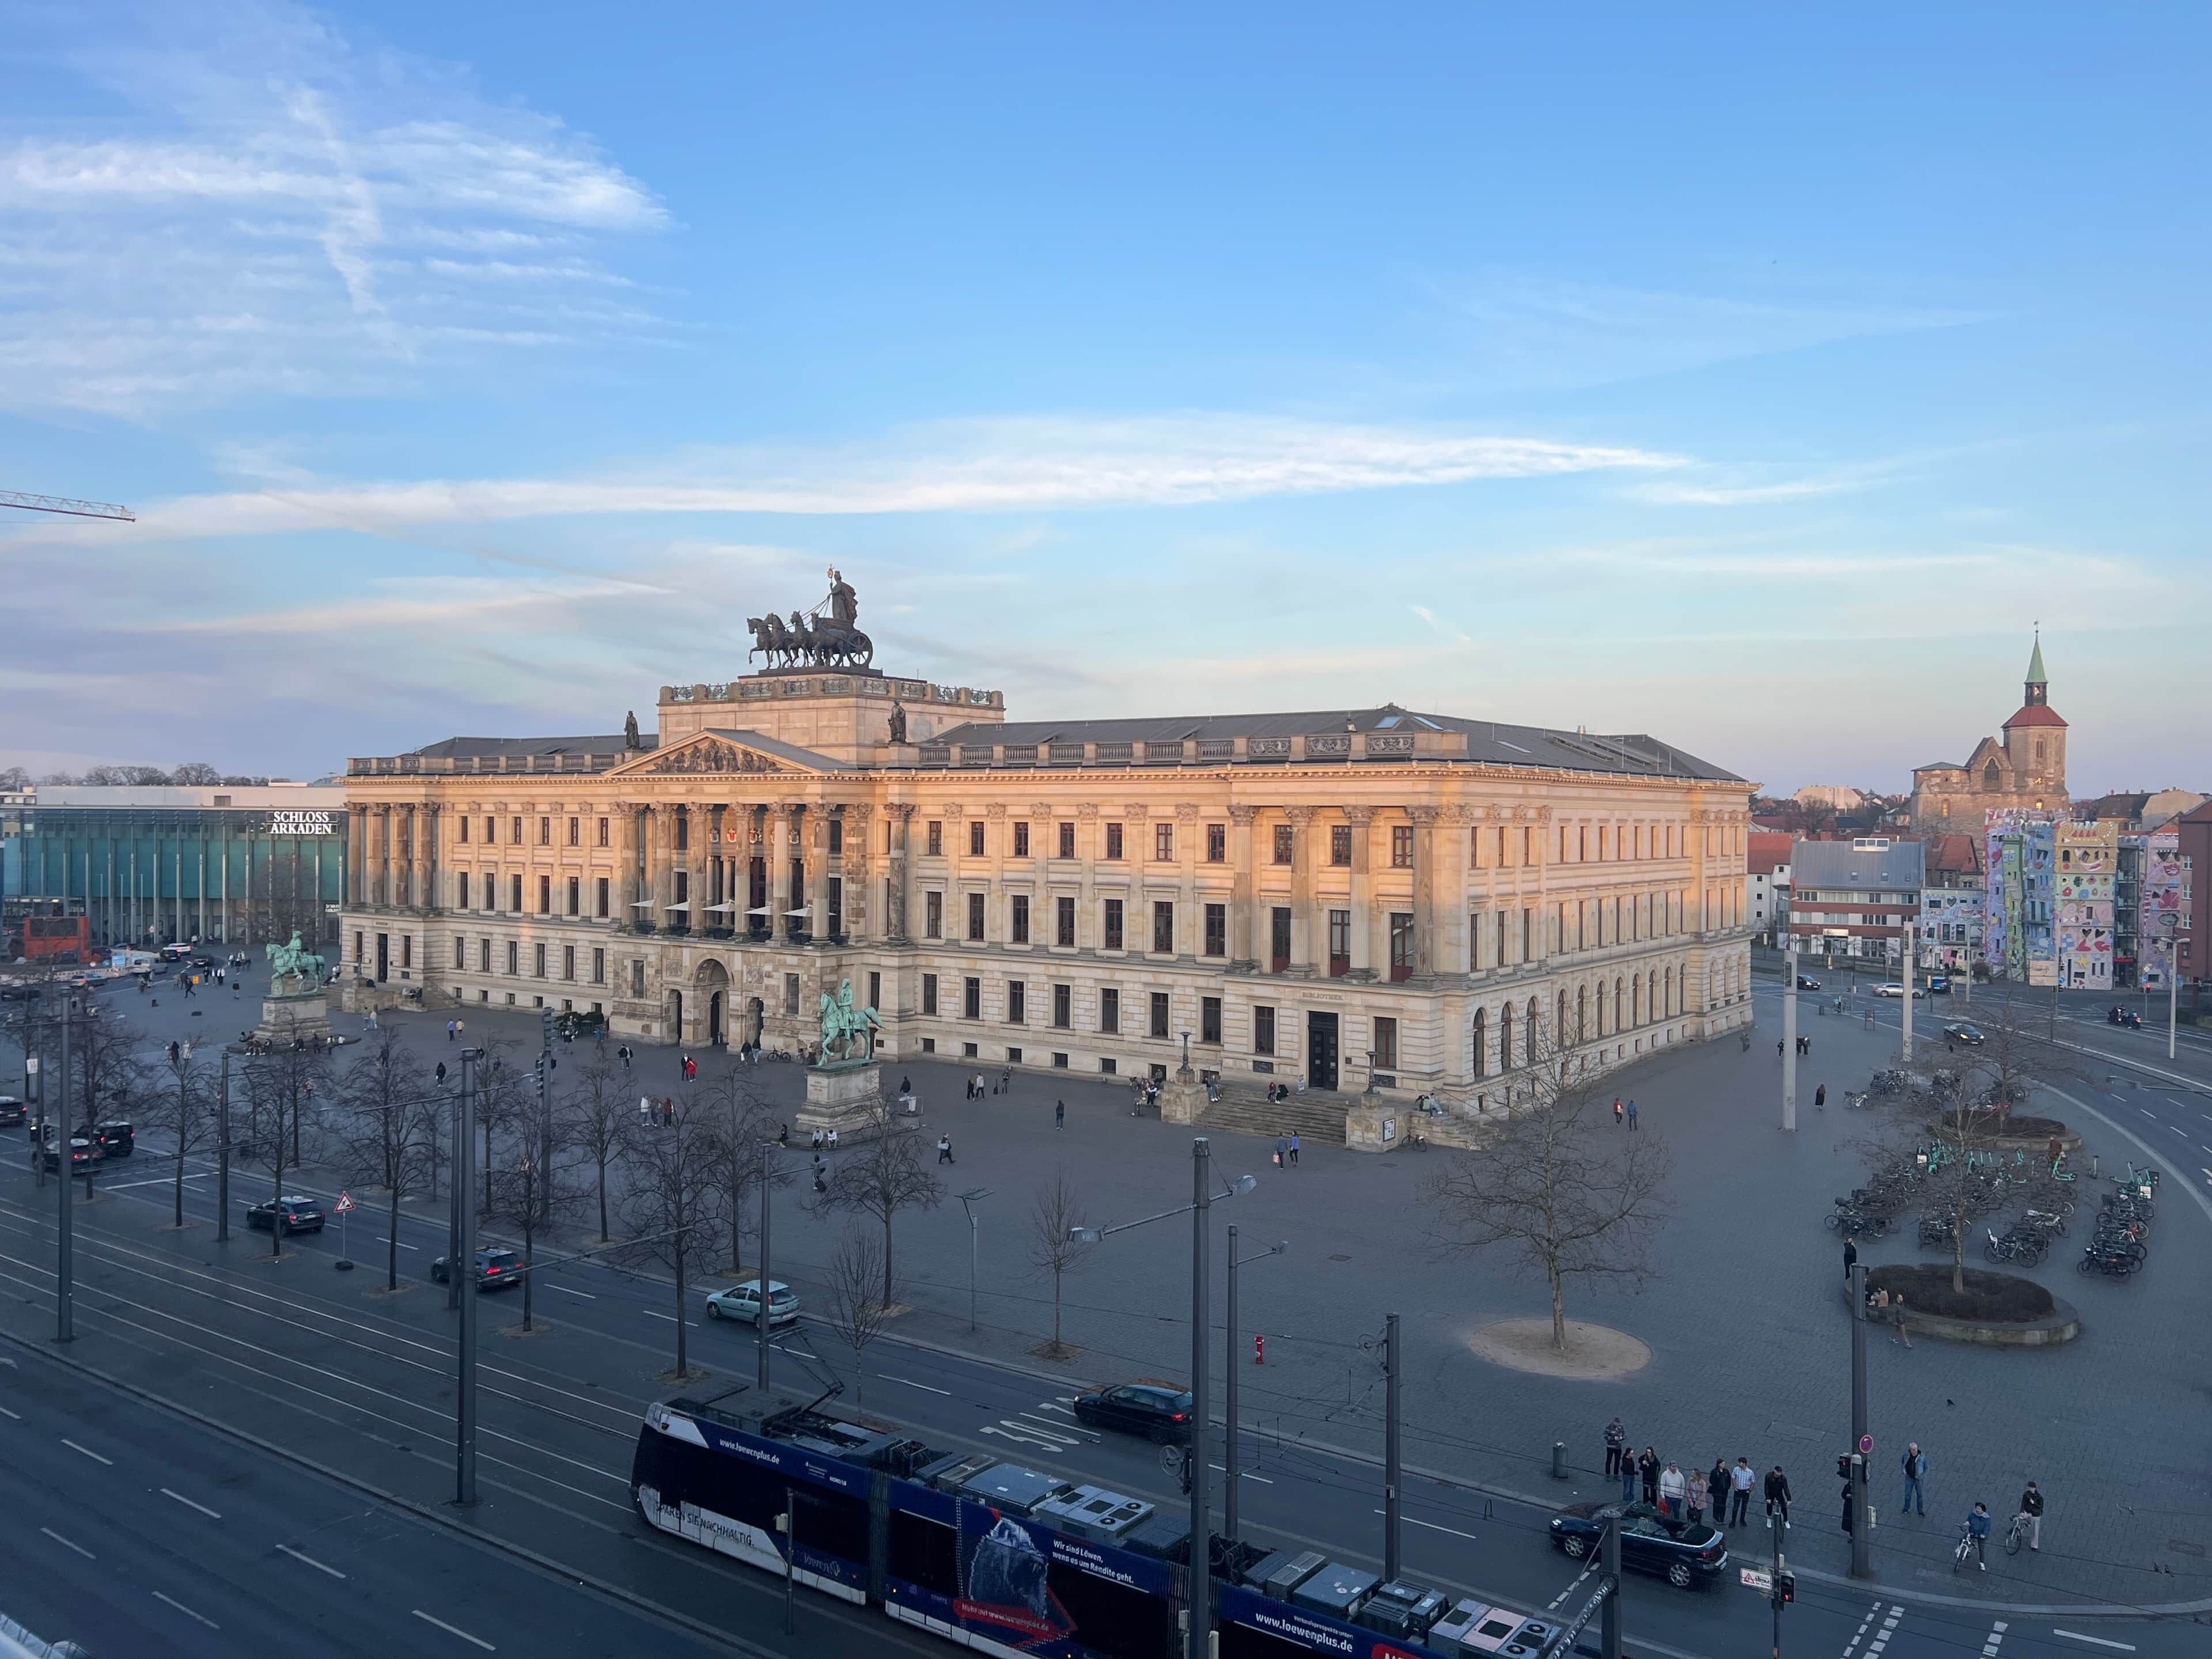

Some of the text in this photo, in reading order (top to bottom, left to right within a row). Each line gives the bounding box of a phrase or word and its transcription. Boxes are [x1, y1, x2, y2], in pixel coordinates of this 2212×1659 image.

[270, 823, 332, 834] ARKADEN
[274, 811, 329, 823] SCHLOSS
[700, 1518, 755, 1547] NACHHALTIG.
[1053, 1539, 1103, 1563] Wir sind Löwen,
[1052, 1551, 1070, 1562] wenn
[1079, 1559, 1089, 1569] um
[1090, 1562, 1115, 1577] Rendite
[1116, 1573, 1134, 1584] geht.
[1255, 1613, 1353, 1653] www.loewenplus.de
